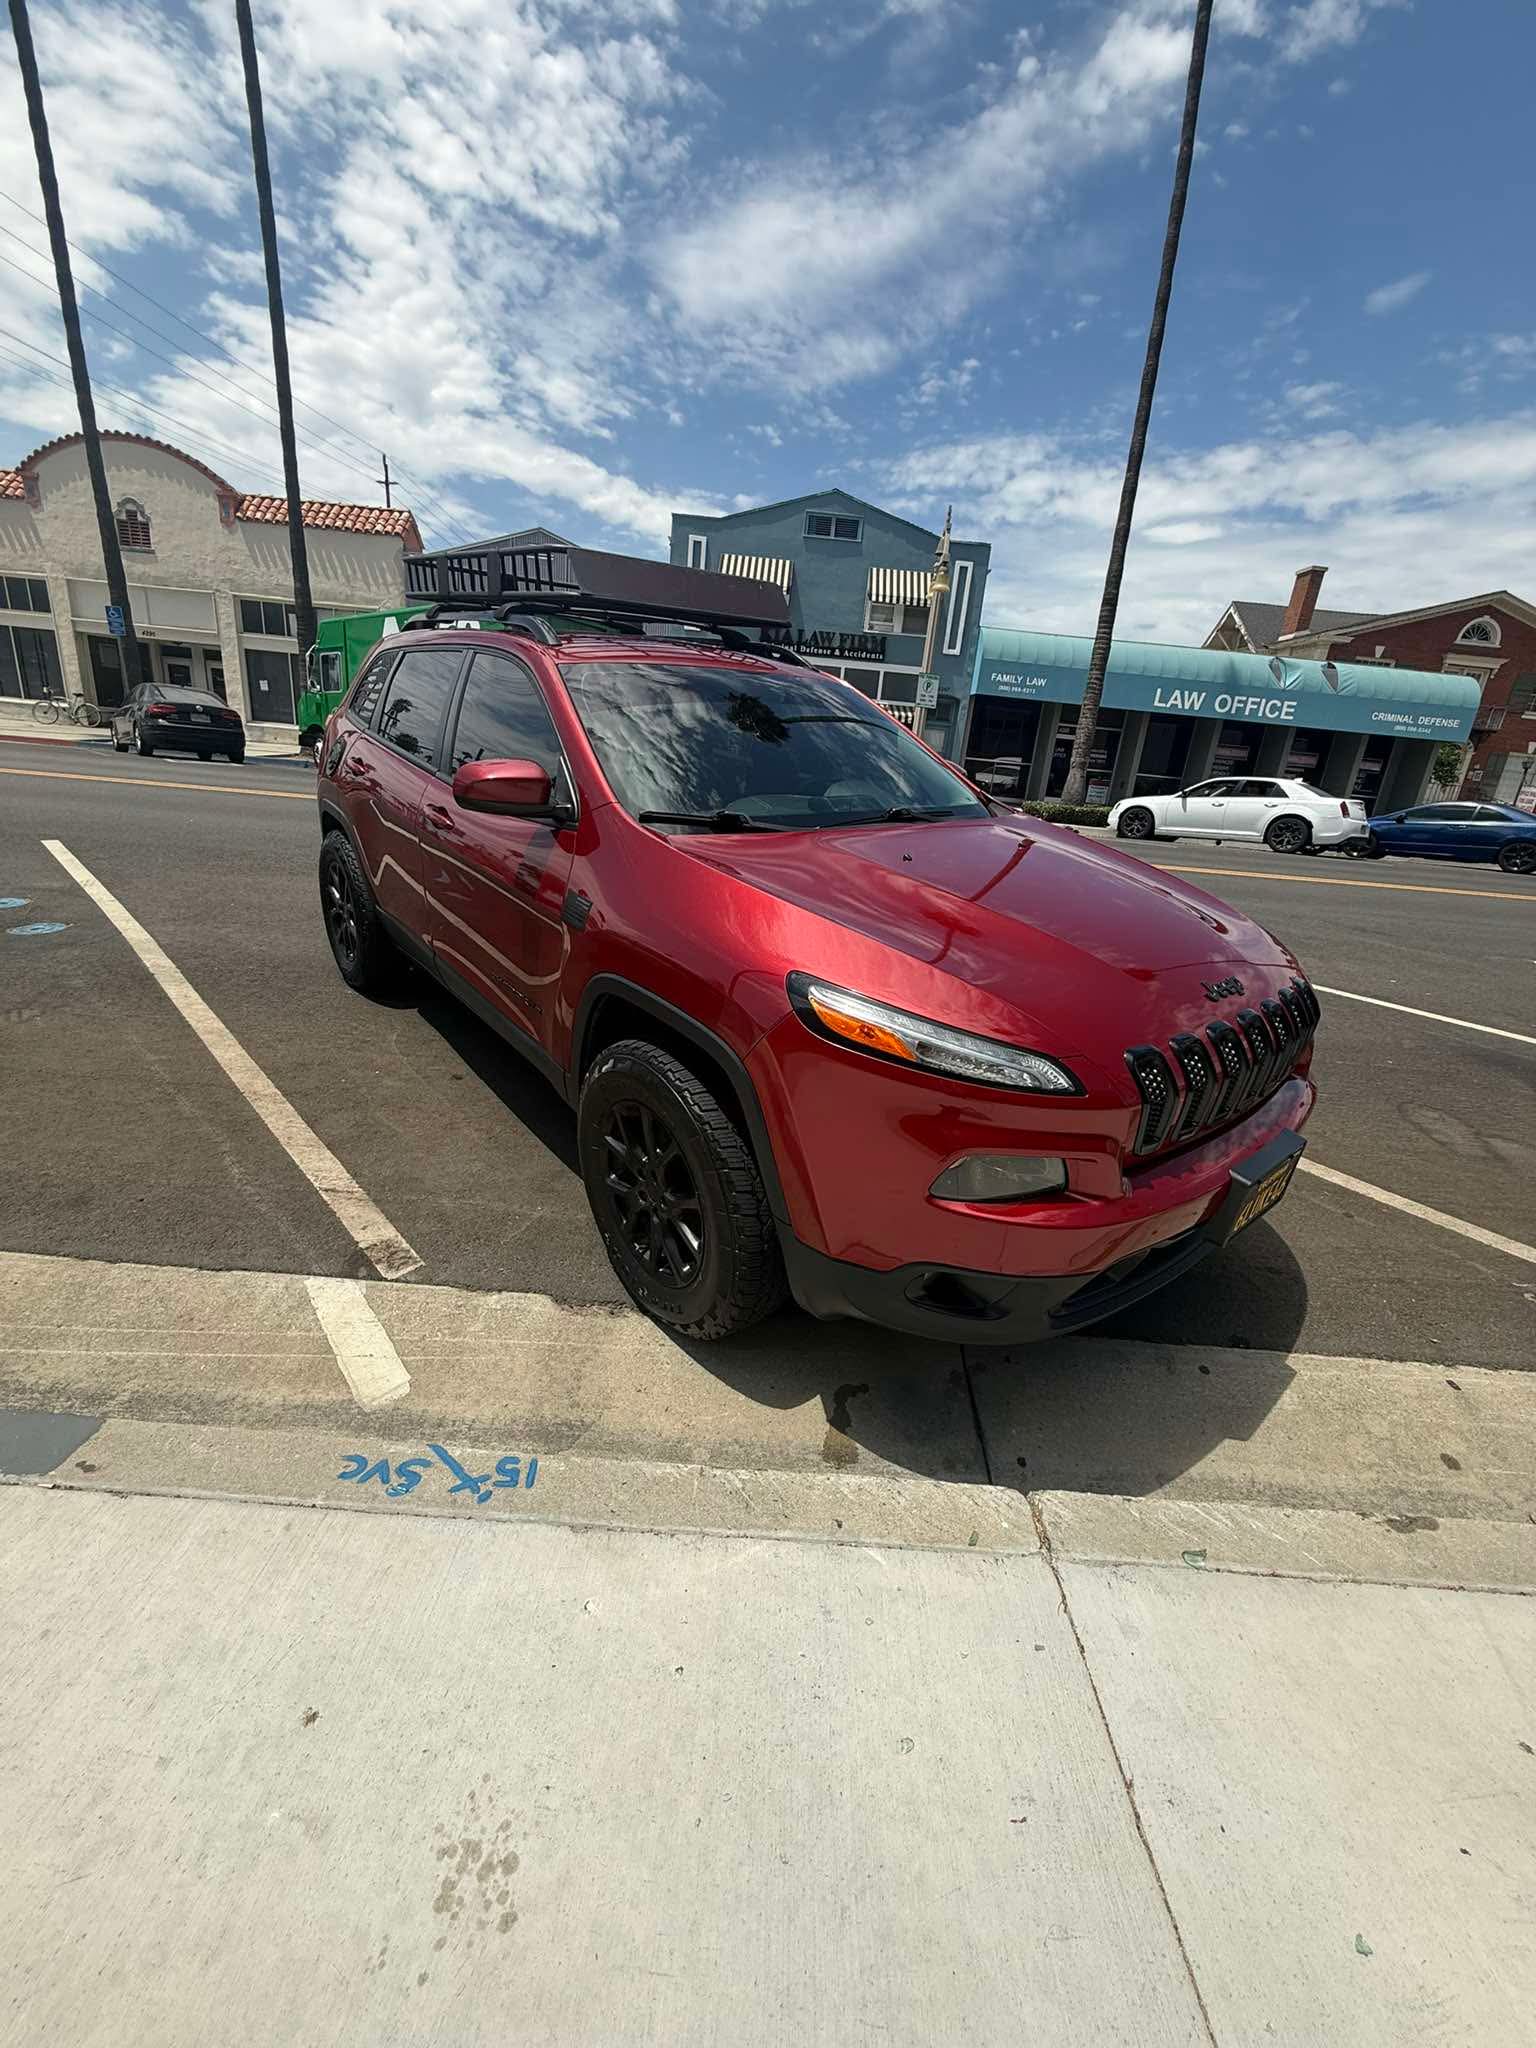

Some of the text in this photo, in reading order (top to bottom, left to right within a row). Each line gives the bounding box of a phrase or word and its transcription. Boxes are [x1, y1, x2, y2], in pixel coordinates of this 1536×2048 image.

[800, 645, 831, 656] Defense
[834, 648, 840, 656] &
[843, 649, 884, 660] Accidents
[991, 672, 1047, 687] FAMILY LAW
[1153, 687, 1298, 720] LAW OFFICE
[1371, 711, 1461, 728] CRIMINAL DEFENSE
[1200, 976, 1245, 1002] Jeep
